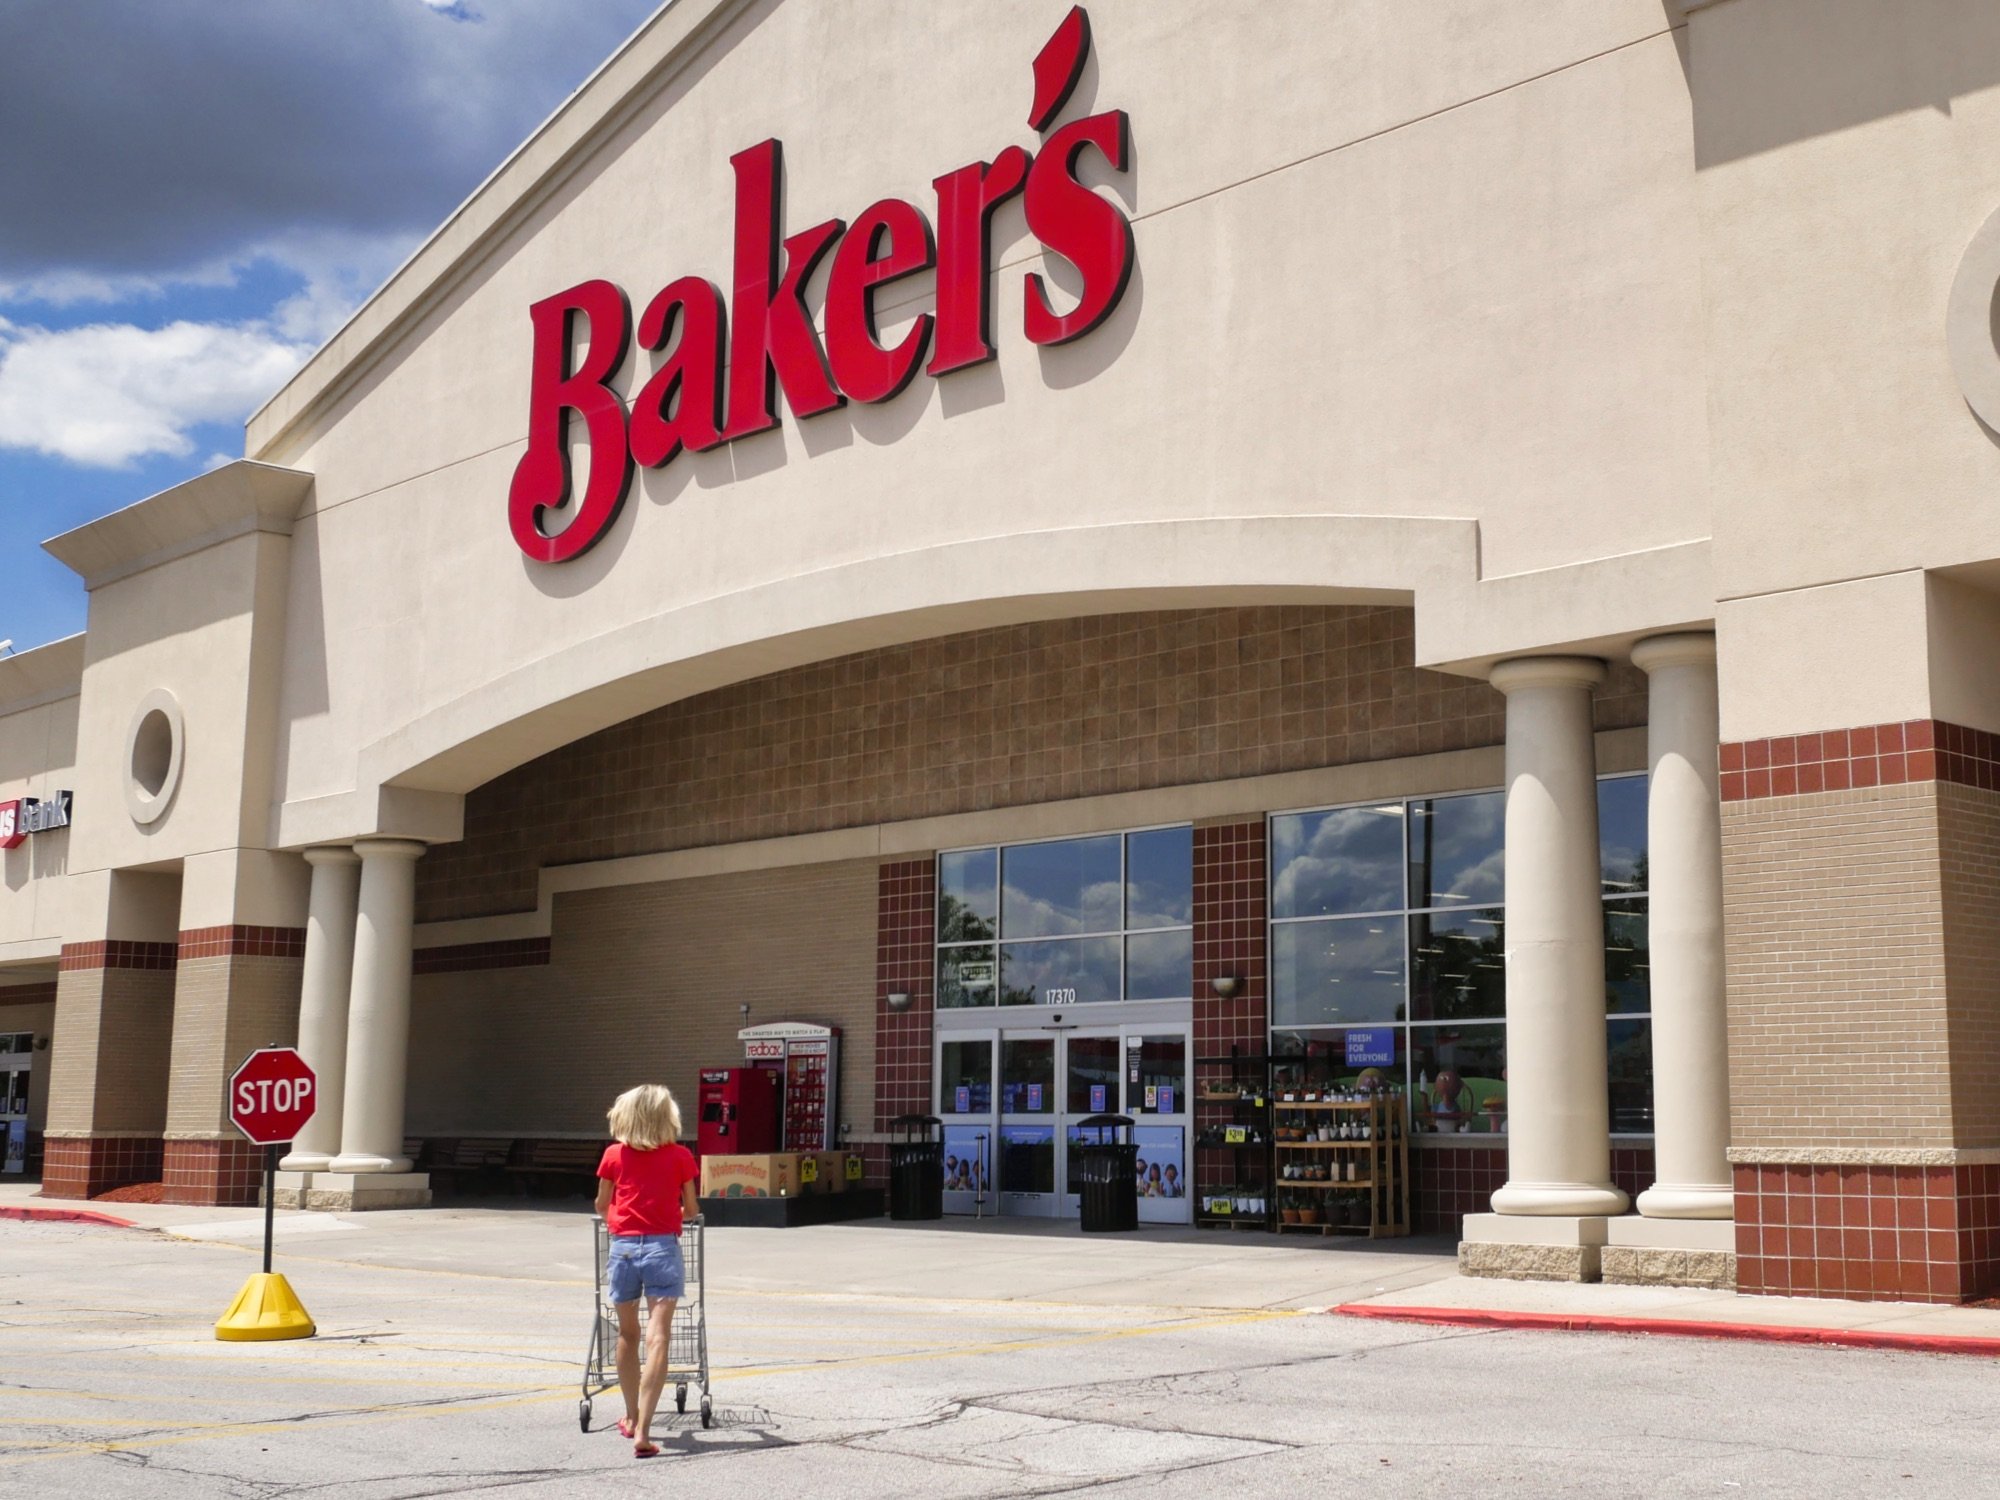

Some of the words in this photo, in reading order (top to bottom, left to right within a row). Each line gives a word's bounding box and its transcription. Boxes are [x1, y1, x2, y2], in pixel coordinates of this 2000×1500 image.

[508, 4, 1134, 562] Baker's
[20, 790, 72, 833] bank
[1046, 988, 1076, 1004] 17370
[1348, 1033, 1372, 1042] FRESH
[1348, 1043, 1364, 1052] FOR
[237, 1077, 312, 1115] STOP
